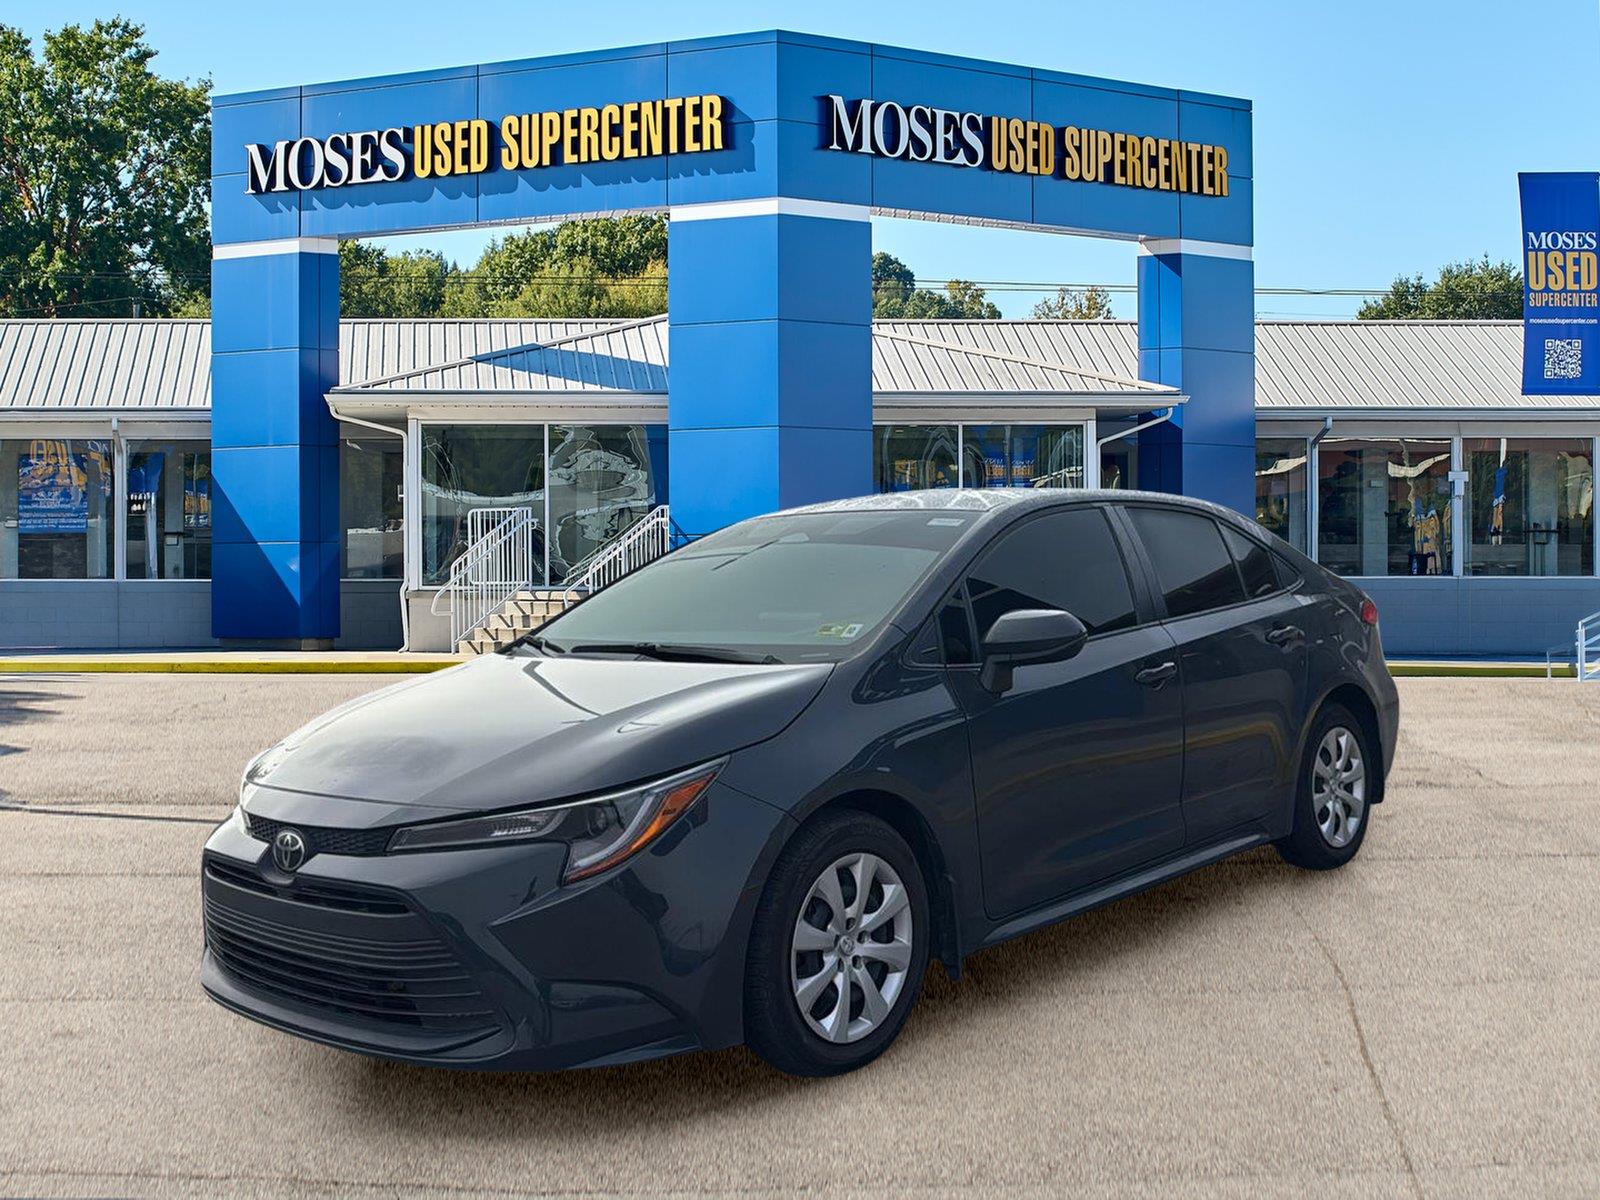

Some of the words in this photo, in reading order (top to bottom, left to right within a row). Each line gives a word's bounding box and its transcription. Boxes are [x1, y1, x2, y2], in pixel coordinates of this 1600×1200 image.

[244, 128, 408, 194] MOSES
[413, 119, 489, 178] USED
[501, 94, 724, 171] SUPERCENTER
[827, 94, 985, 168] MOSES
[991, 115, 1055, 177] USED
[1064, 125, 1229, 197] SUPERCENTER
[1527, 231, 1597, 250] MOSES
[1528, 251, 1598, 291] USED
[1529, 292, 1598, 308] SUPERCENTER
